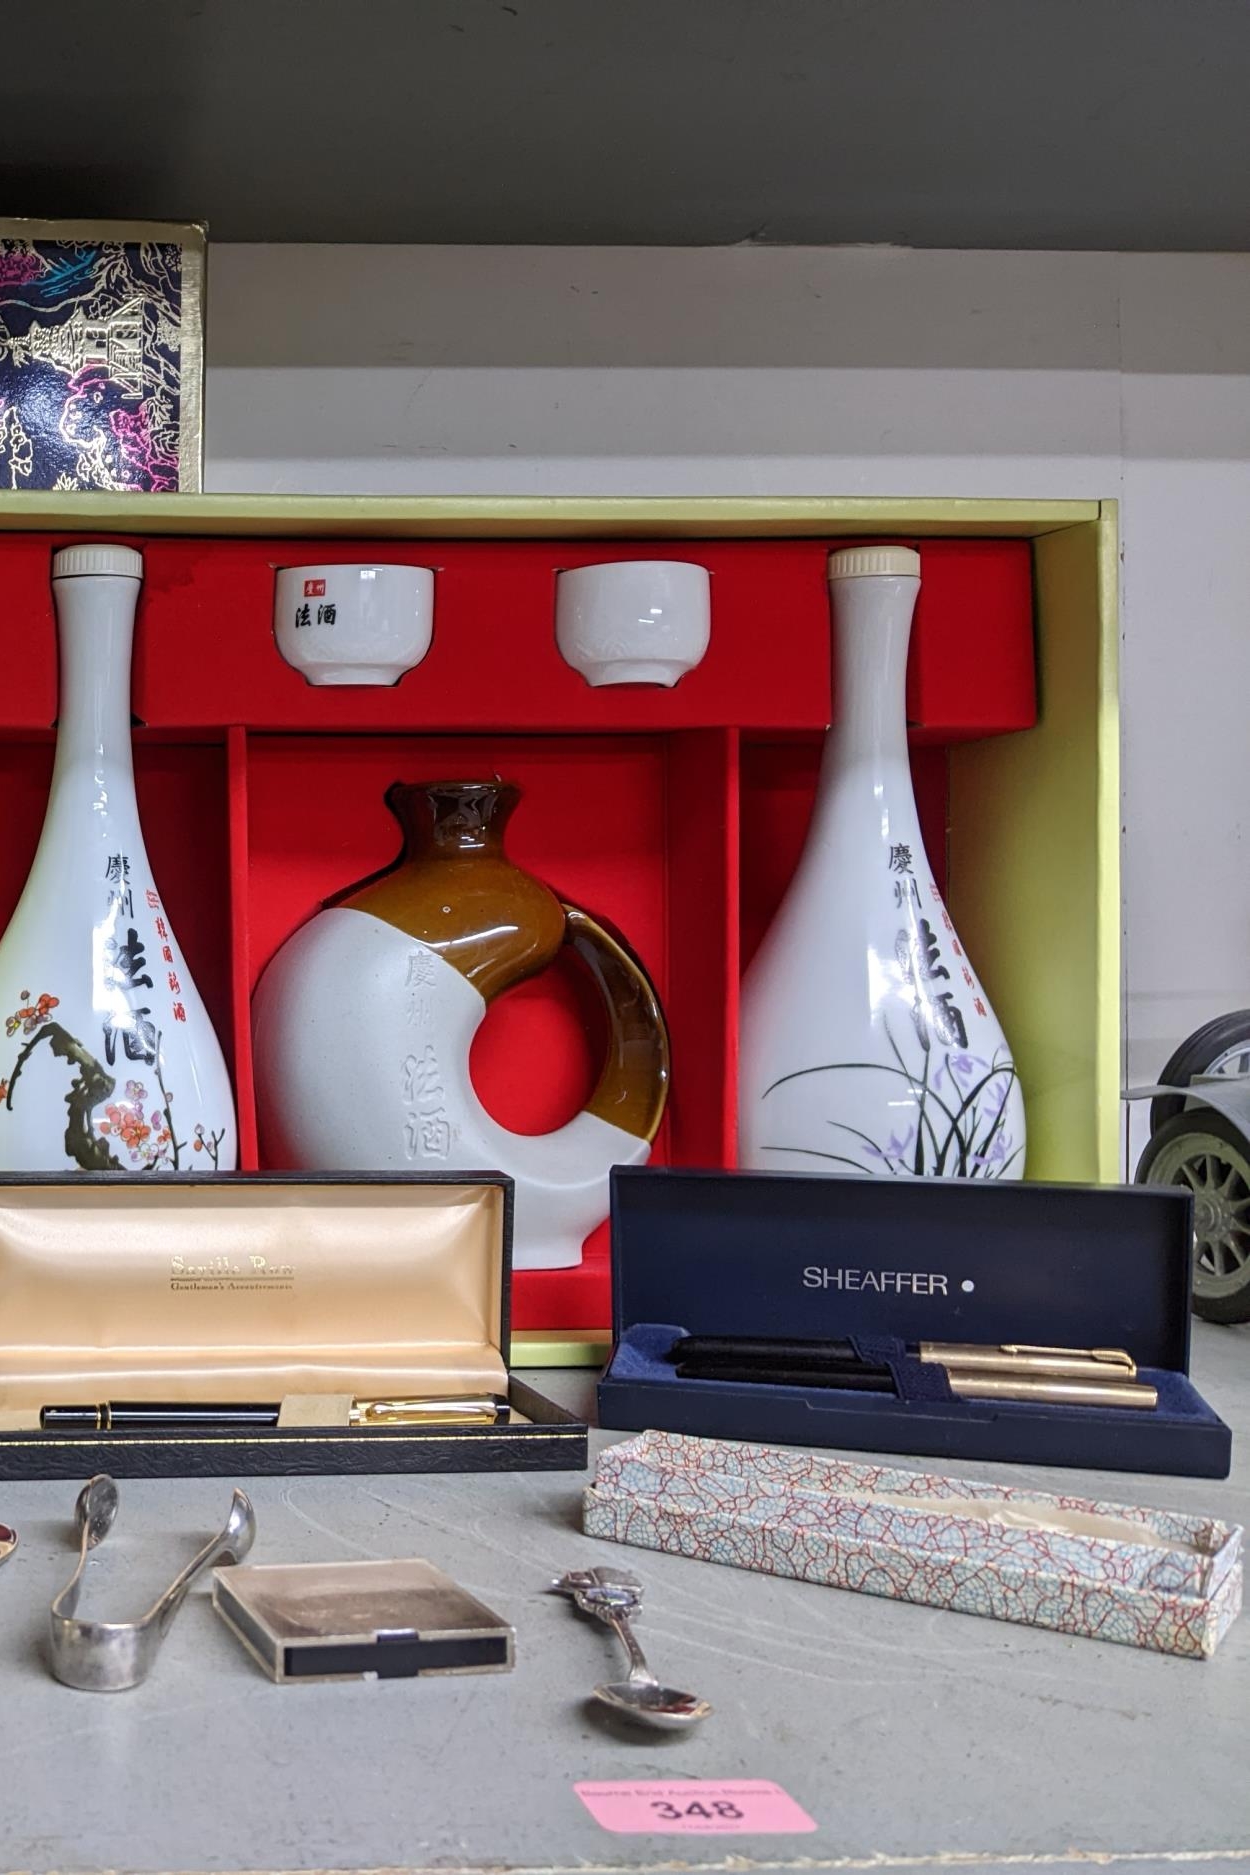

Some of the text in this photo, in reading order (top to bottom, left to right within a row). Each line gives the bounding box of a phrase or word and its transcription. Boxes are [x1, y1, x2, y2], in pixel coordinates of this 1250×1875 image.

[295, 603, 337, 629] 法酒
[803, 1266, 948, 1297] SHEAFFER
[650, 1800, 745, 1821] 348
